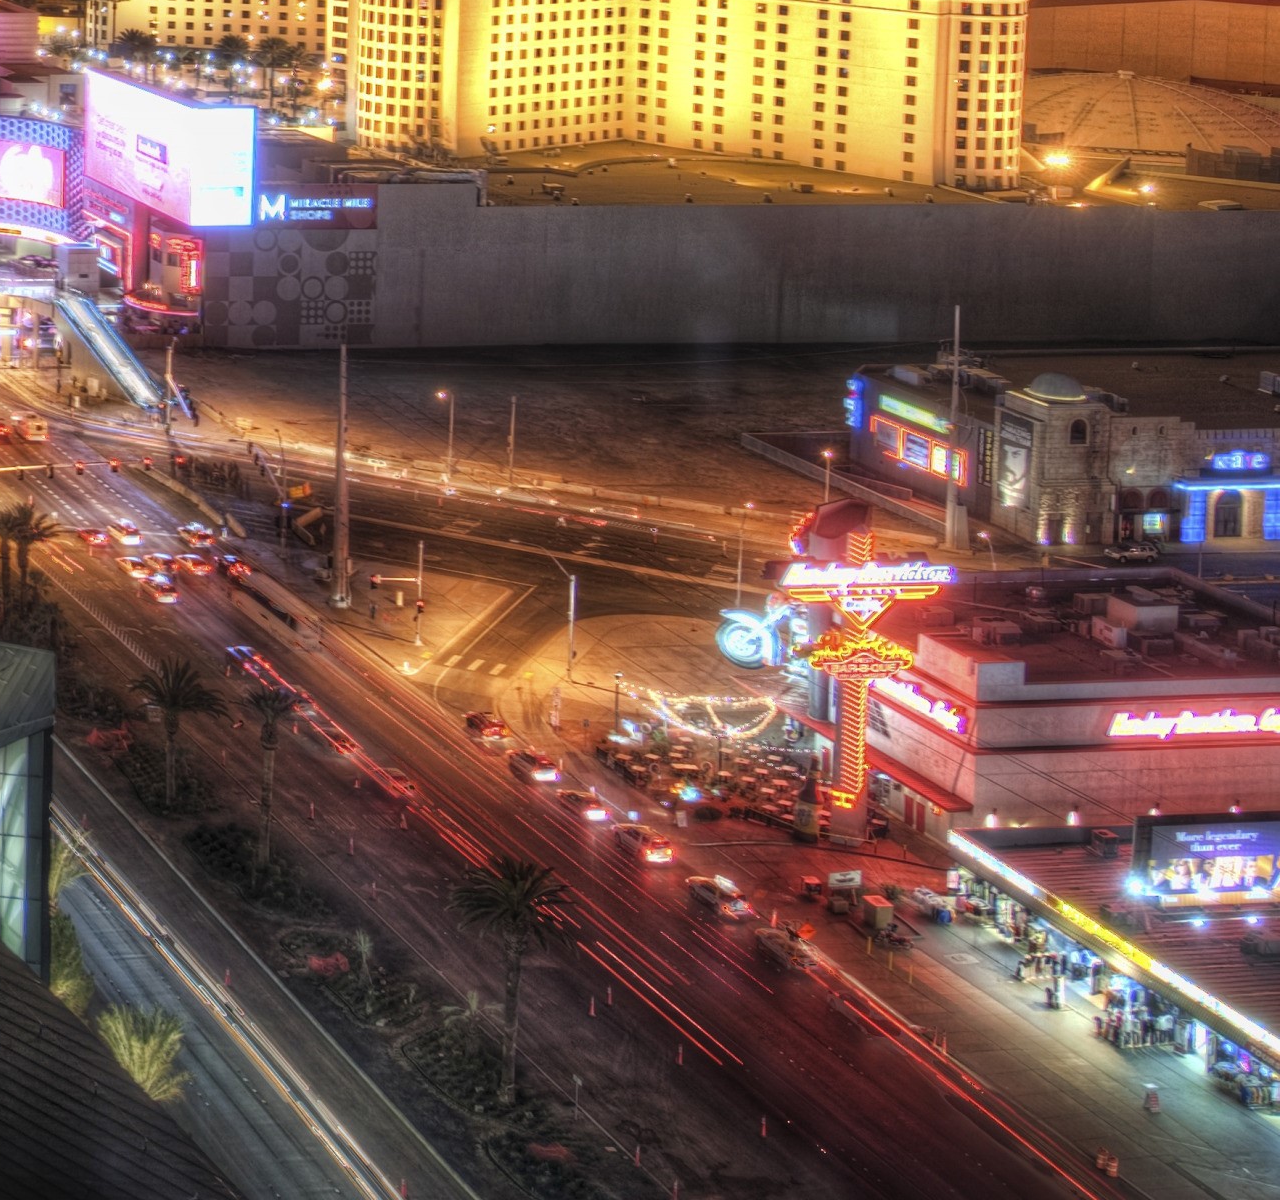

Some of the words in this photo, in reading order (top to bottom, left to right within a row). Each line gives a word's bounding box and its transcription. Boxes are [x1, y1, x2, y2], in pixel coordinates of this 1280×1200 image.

[289, 199, 341, 208] MIRACLE
[342, 199, 372, 208] MILE
[289, 210, 333, 220] SHOPS
[1176, 831, 1204, 842] More
[1206, 830, 1259, 842] legendary
[1190, 843, 1214, 852] than
[1217, 843, 1241, 851] ever
